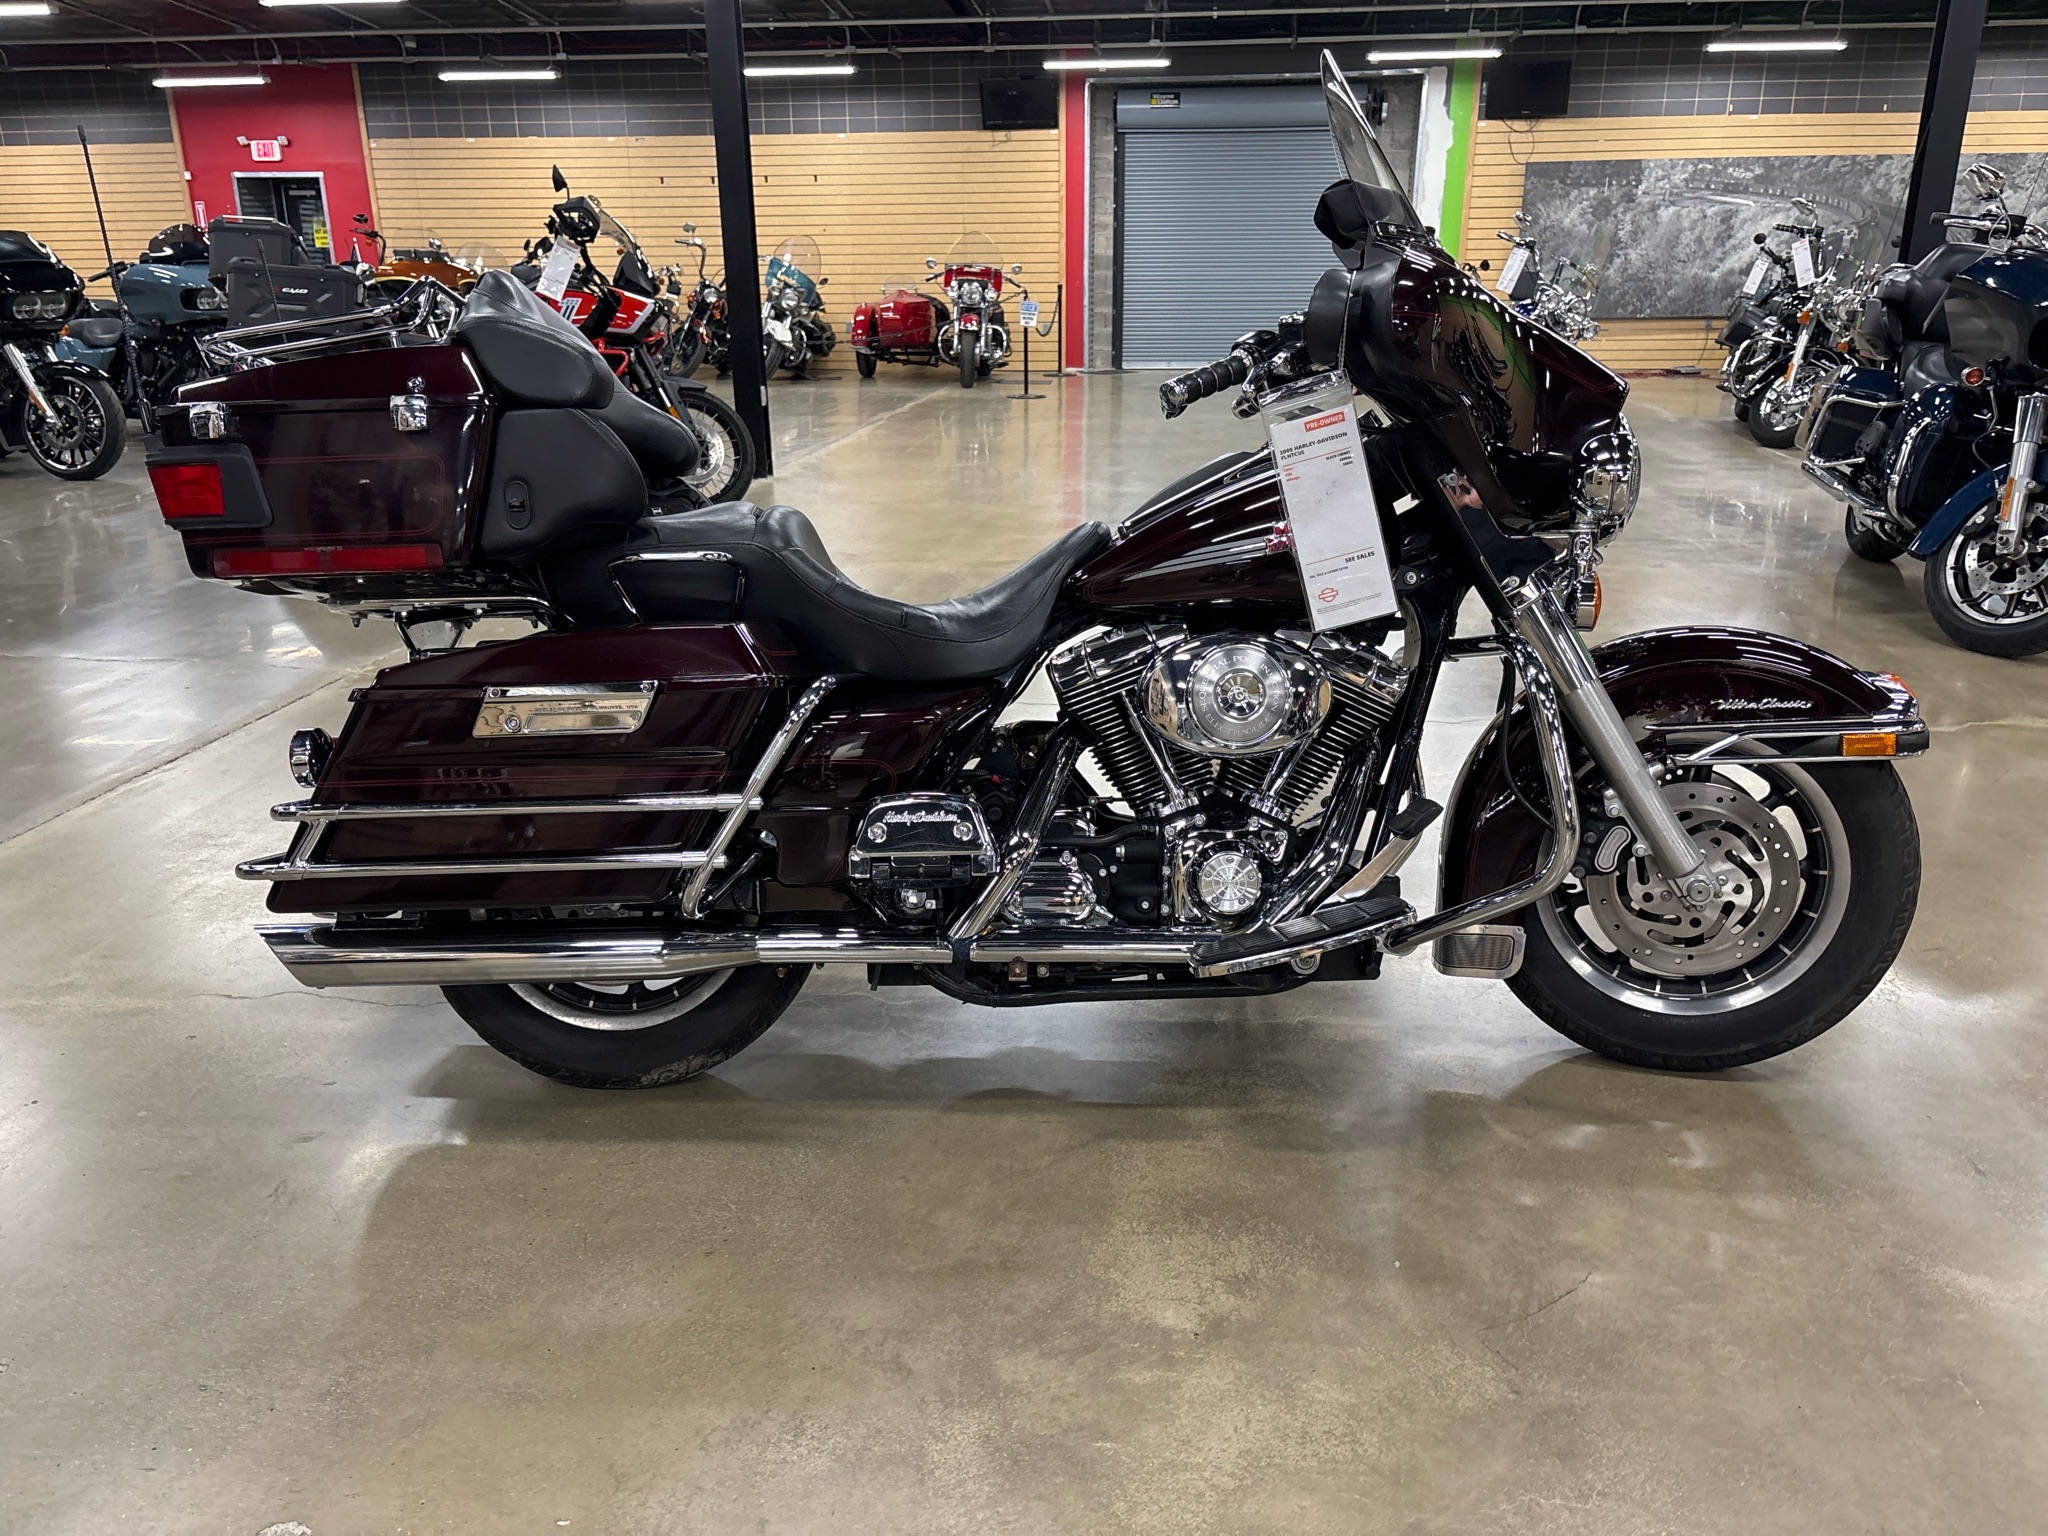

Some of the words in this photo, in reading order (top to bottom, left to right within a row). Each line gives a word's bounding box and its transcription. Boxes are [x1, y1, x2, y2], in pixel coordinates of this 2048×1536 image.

[256, 142, 275, 158] EXIT
[1306, 414, 1344, 430] PRE-OWNED
[1279, 446, 1294, 456] 2005
[1294, 431, 1348, 451] HARLEY-DAVIDSON
[1344, 556, 1356, 564] SEE
[1356, 550, 1375, 561] SALES
[1759, 697, 1813, 710] Classic
